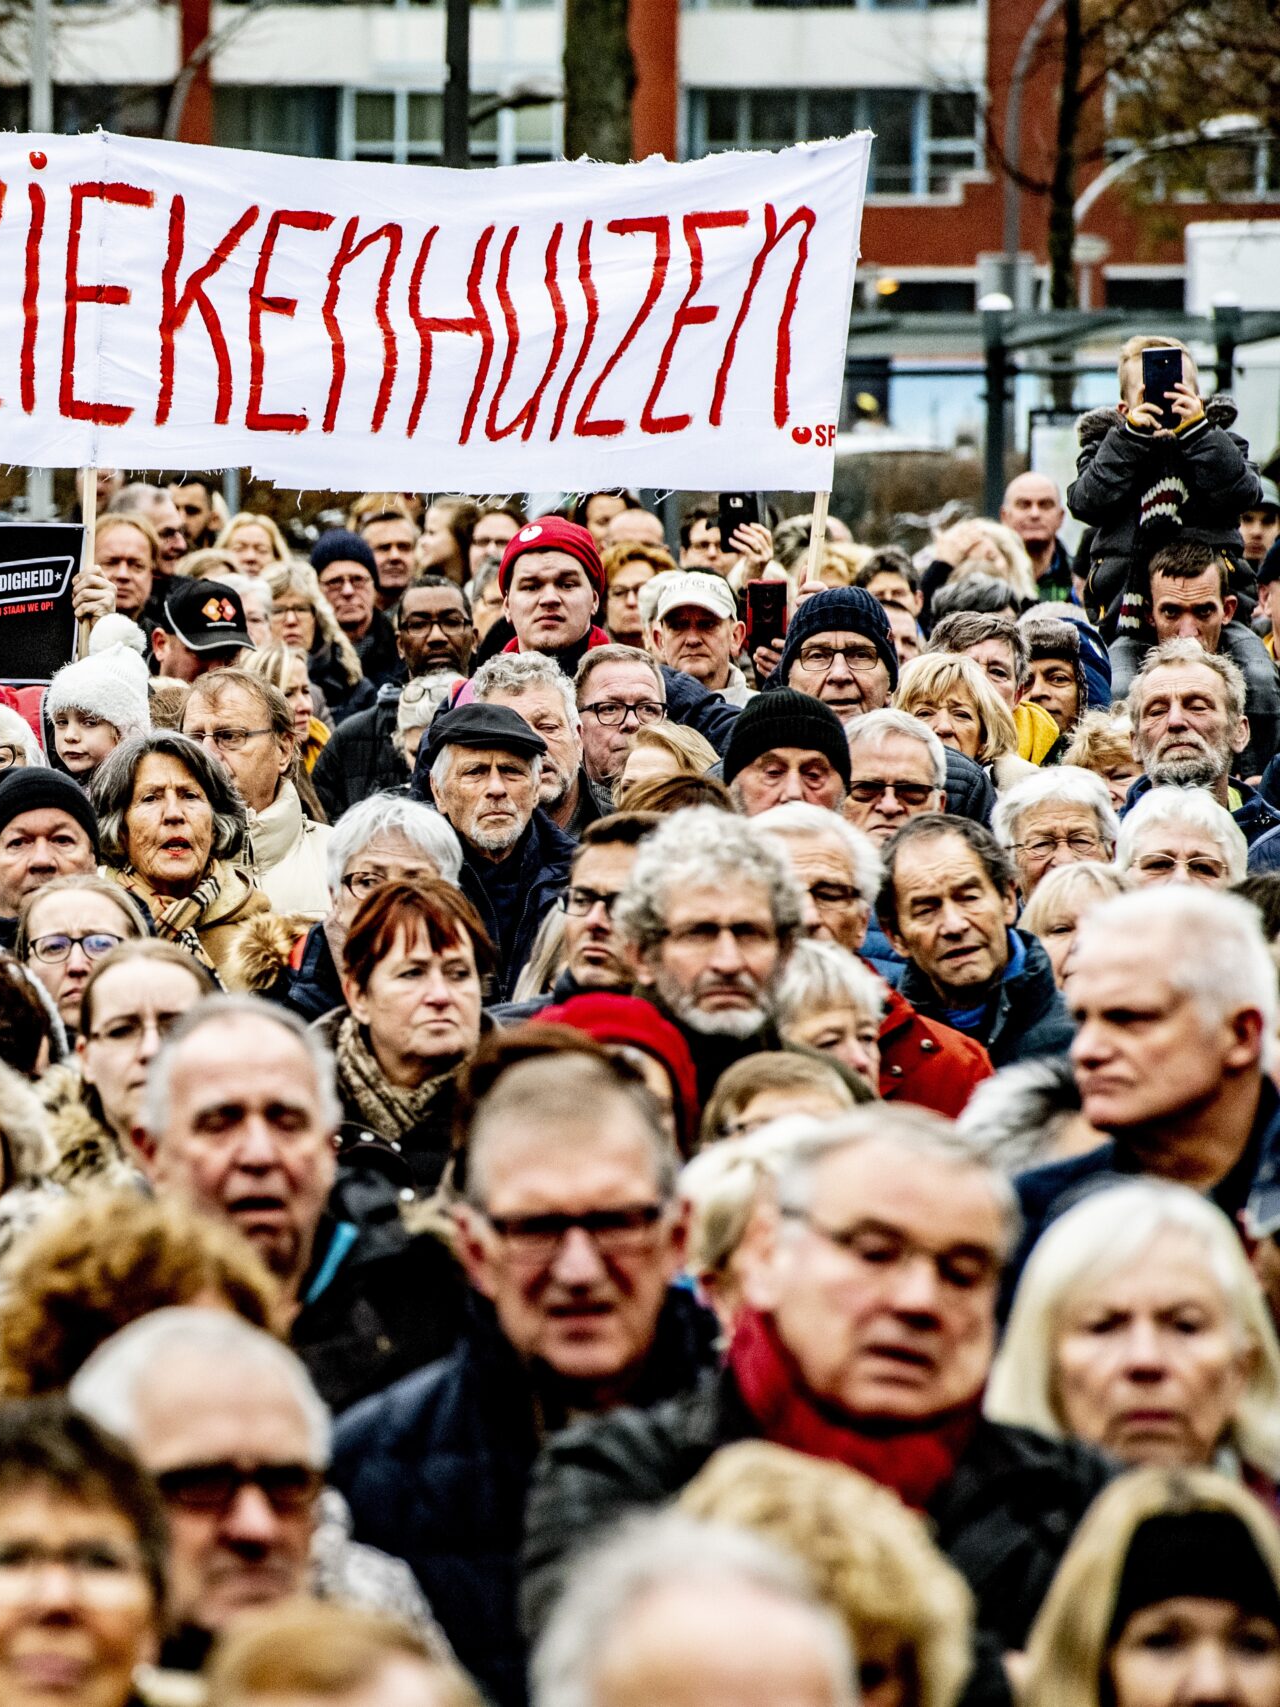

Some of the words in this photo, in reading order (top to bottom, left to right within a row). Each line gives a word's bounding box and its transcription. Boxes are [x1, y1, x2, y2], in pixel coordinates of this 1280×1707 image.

[3, 604, 26, 616] STAAN
[28, 602, 39, 612] WE
[41, 601, 54, 611] OP!
